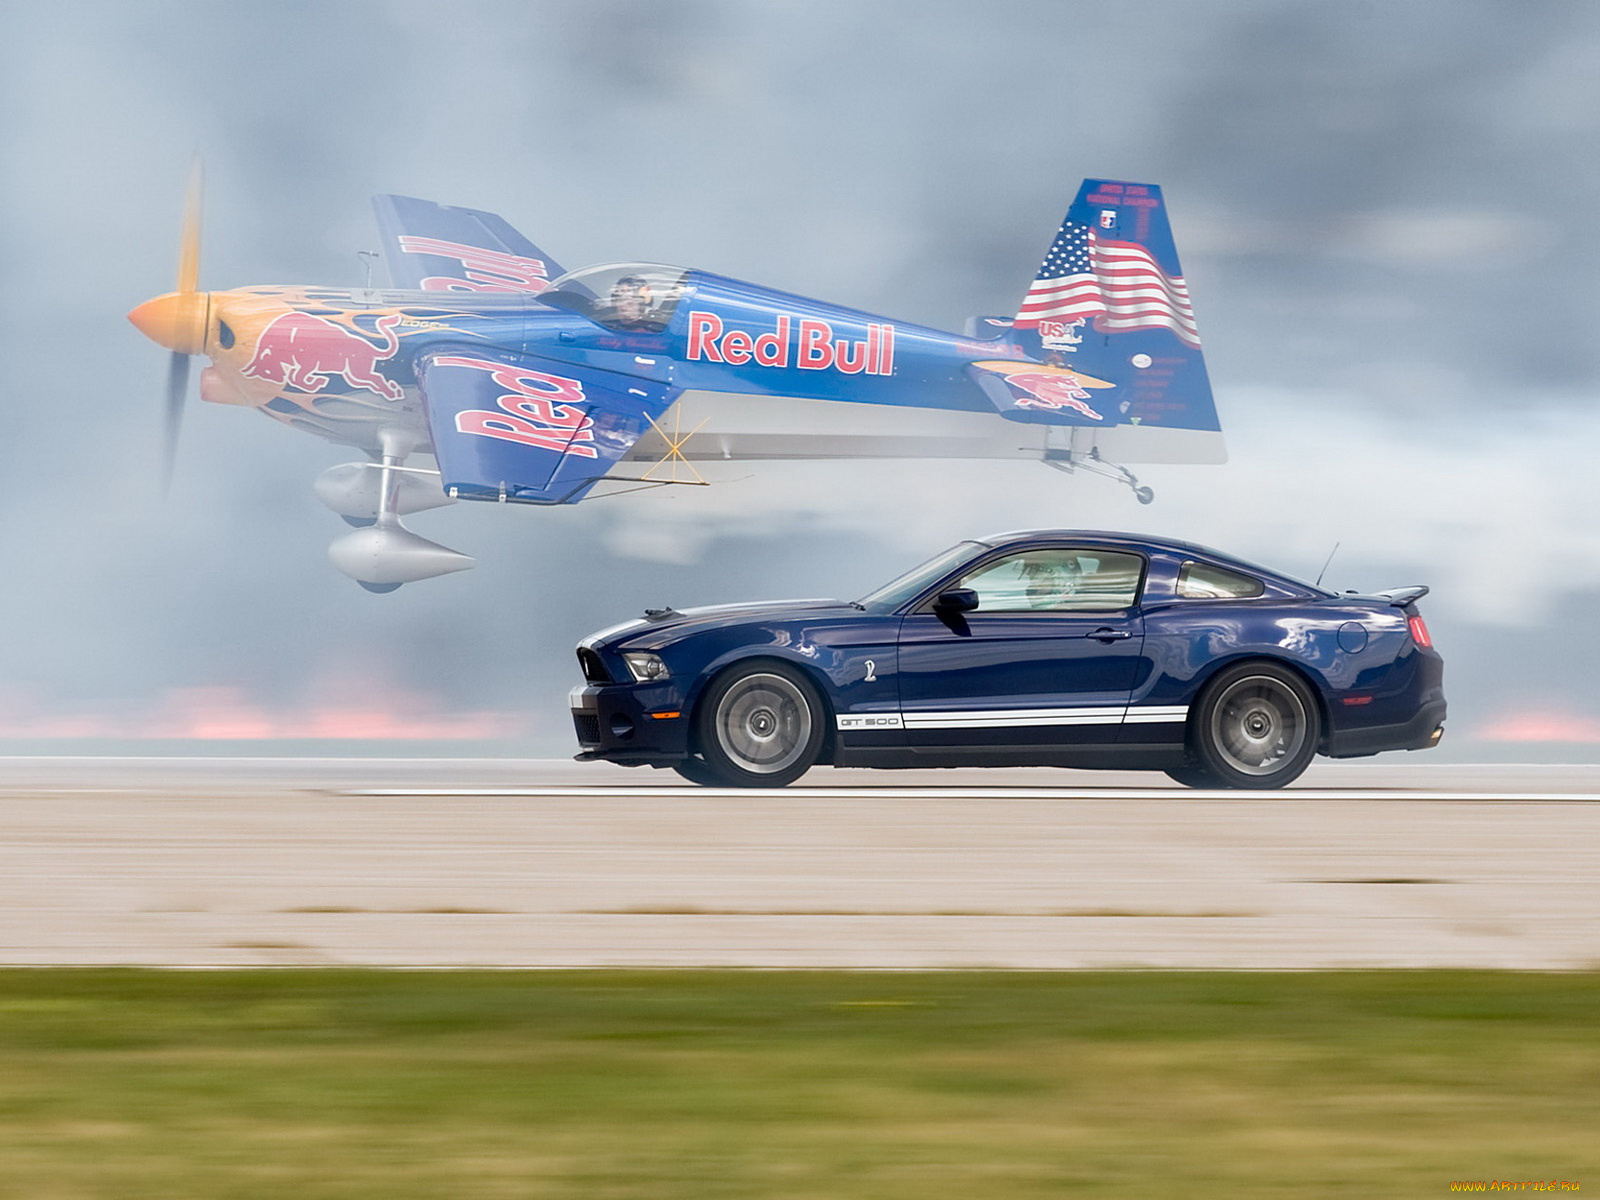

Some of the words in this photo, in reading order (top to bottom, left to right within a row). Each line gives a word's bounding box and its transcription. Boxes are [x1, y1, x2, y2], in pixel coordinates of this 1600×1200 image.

[687, 311, 790, 368] Red
[797, 318, 894, 376] Bull
[433, 356, 598, 459] Red
[841, 718, 863, 726] GT
[865, 718, 899, 726] 500
